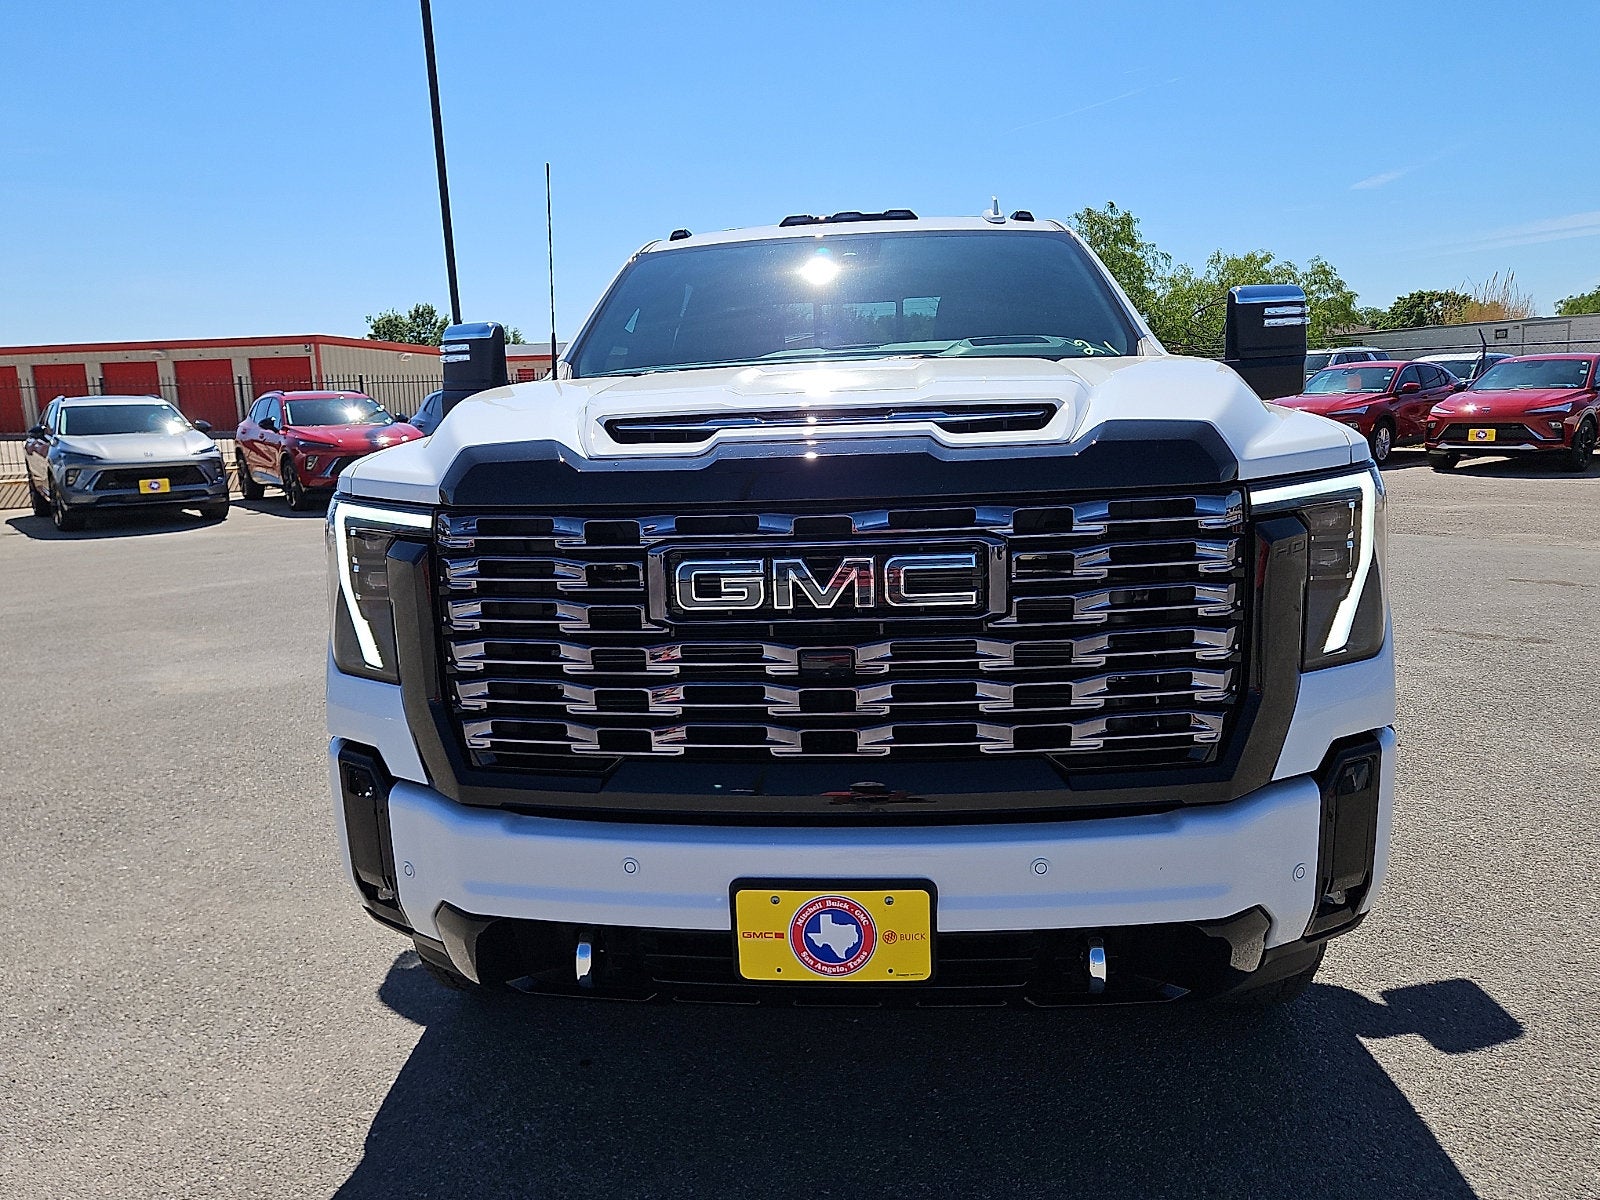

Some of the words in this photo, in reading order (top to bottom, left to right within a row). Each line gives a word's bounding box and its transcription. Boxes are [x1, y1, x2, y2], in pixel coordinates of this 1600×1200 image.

[675, 552, 978, 611] GMC
[796, 902, 823, 927] Mitchell
[825, 900, 850, 909] Buick
[854, 909, 869, 926] GMC
[742, 931, 774, 939] GMC
[900, 933, 926, 941] BUICK
[801, 951, 814, 965] San
[814, 962, 848, 973] Angelo,
[847, 951, 868, 969] Texas
